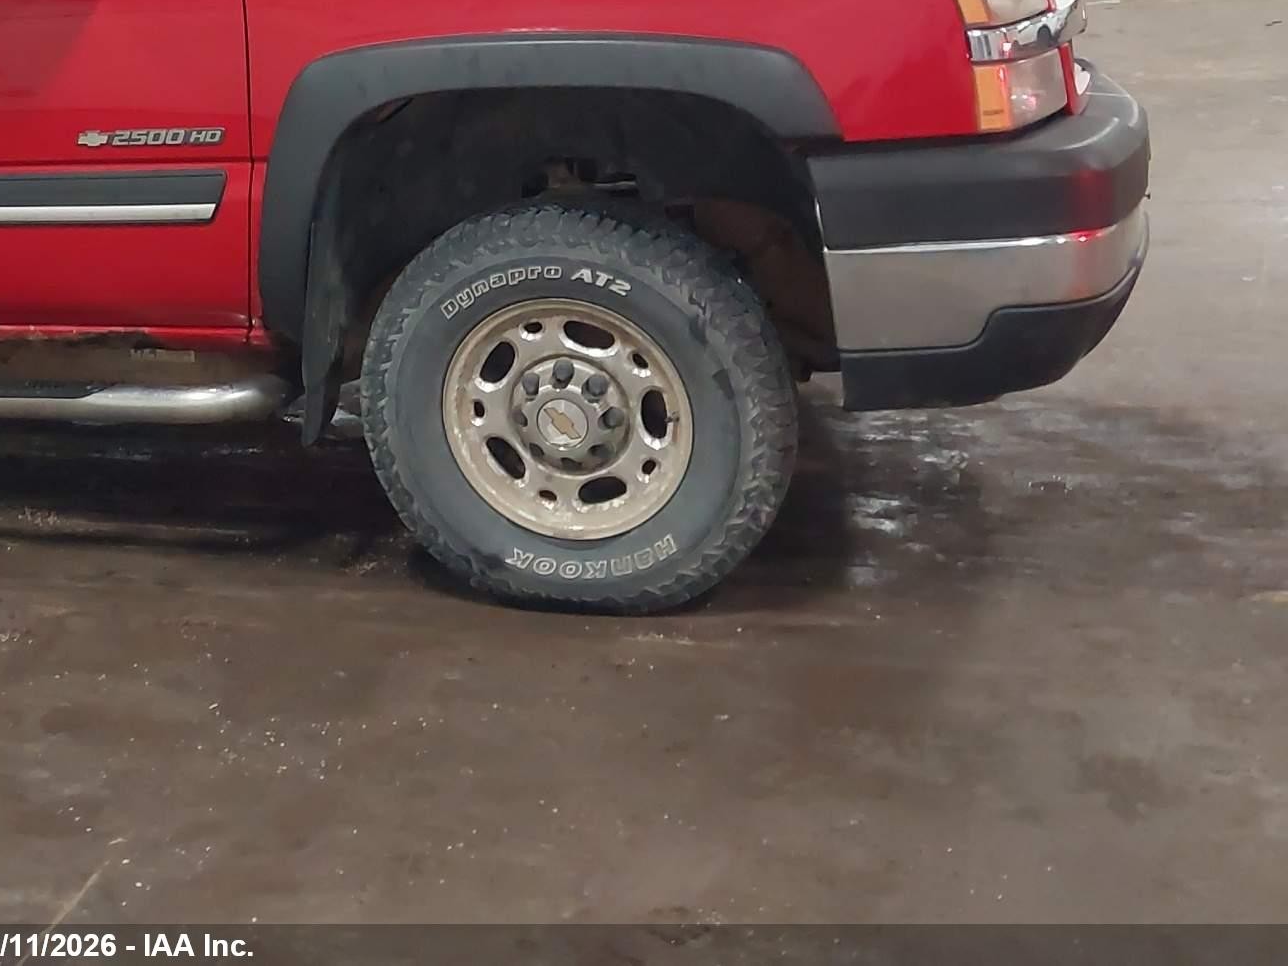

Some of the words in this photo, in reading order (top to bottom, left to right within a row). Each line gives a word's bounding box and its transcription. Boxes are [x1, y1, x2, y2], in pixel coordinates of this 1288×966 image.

[111, 128, 186, 146] 2500
[189, 129, 223, 143] HD
[440, 265, 562, 320] Dynapro
[570, 267, 633, 297] AT2
